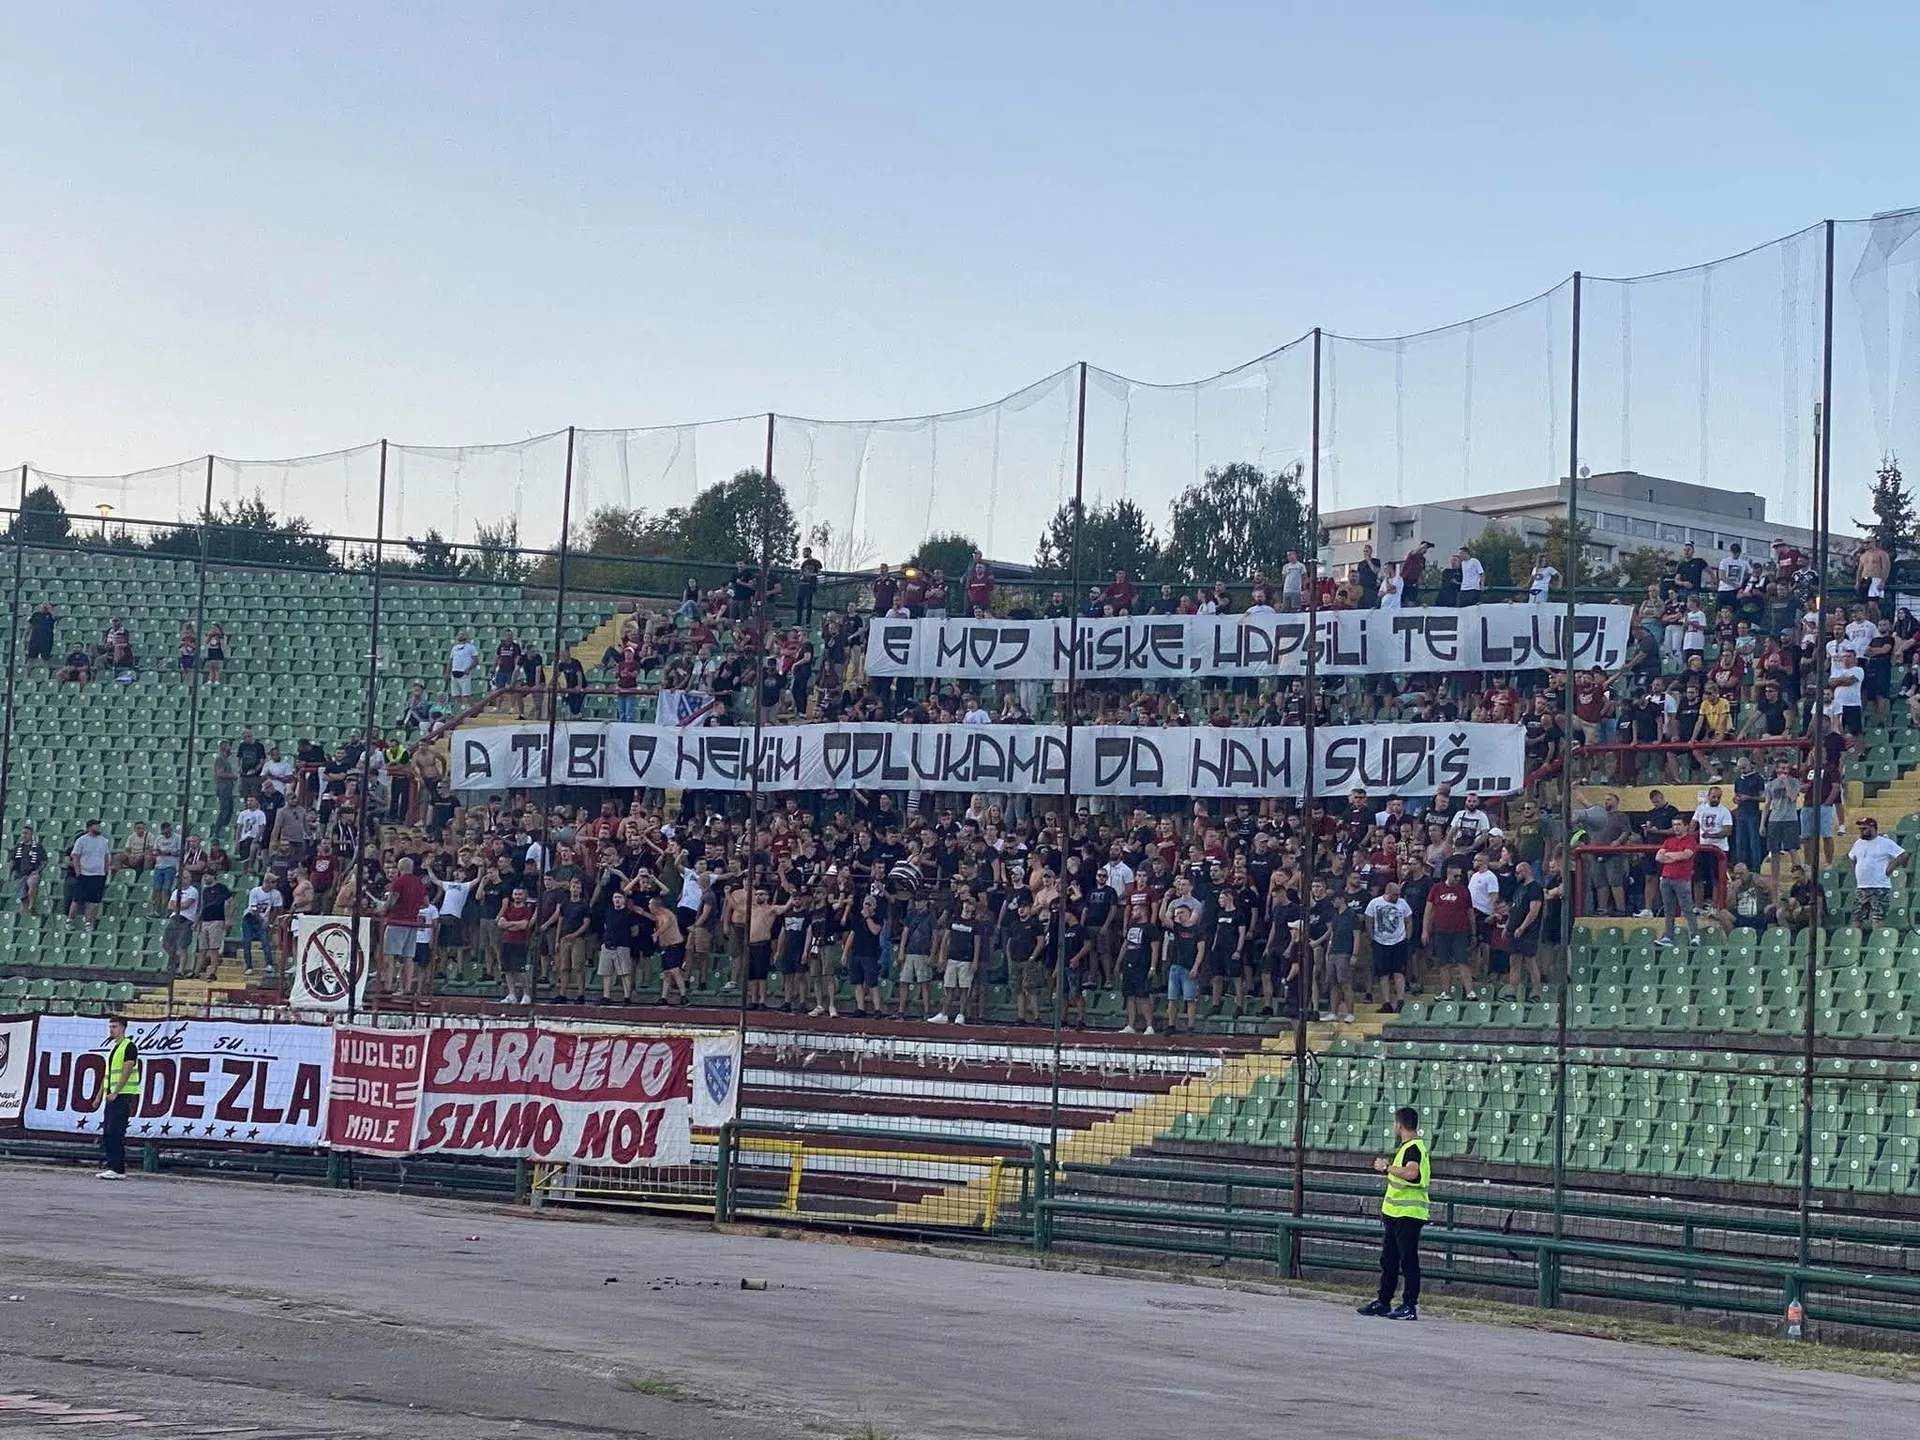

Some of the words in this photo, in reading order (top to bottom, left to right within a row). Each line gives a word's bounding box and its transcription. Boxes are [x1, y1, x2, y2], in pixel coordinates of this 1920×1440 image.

[936, 625, 1031, 670] MOJ
[1392, 616, 1458, 662] TE
[465, 739, 493, 779] A
[511, 733, 549, 777] Ti
[567, 733, 606, 779] Bi
[628, 734, 658, 778] O
[823, 732, 1071, 784] ODLUKAMA
[1094, 737, 1164, 788] DA
[1190, 737, 1293, 789] NAM
[340, 1038, 418, 1070] NUCLEO
[433, 1031, 674, 1097] SARAJEVO
[215, 1059, 323, 1127] ZLA
[356, 1078, 395, 1108] DEL
[345, 1113, 399, 1142] MALE
[418, 1099, 564, 1157] SIAMO
[573, 1108, 666, 1164] NOI
